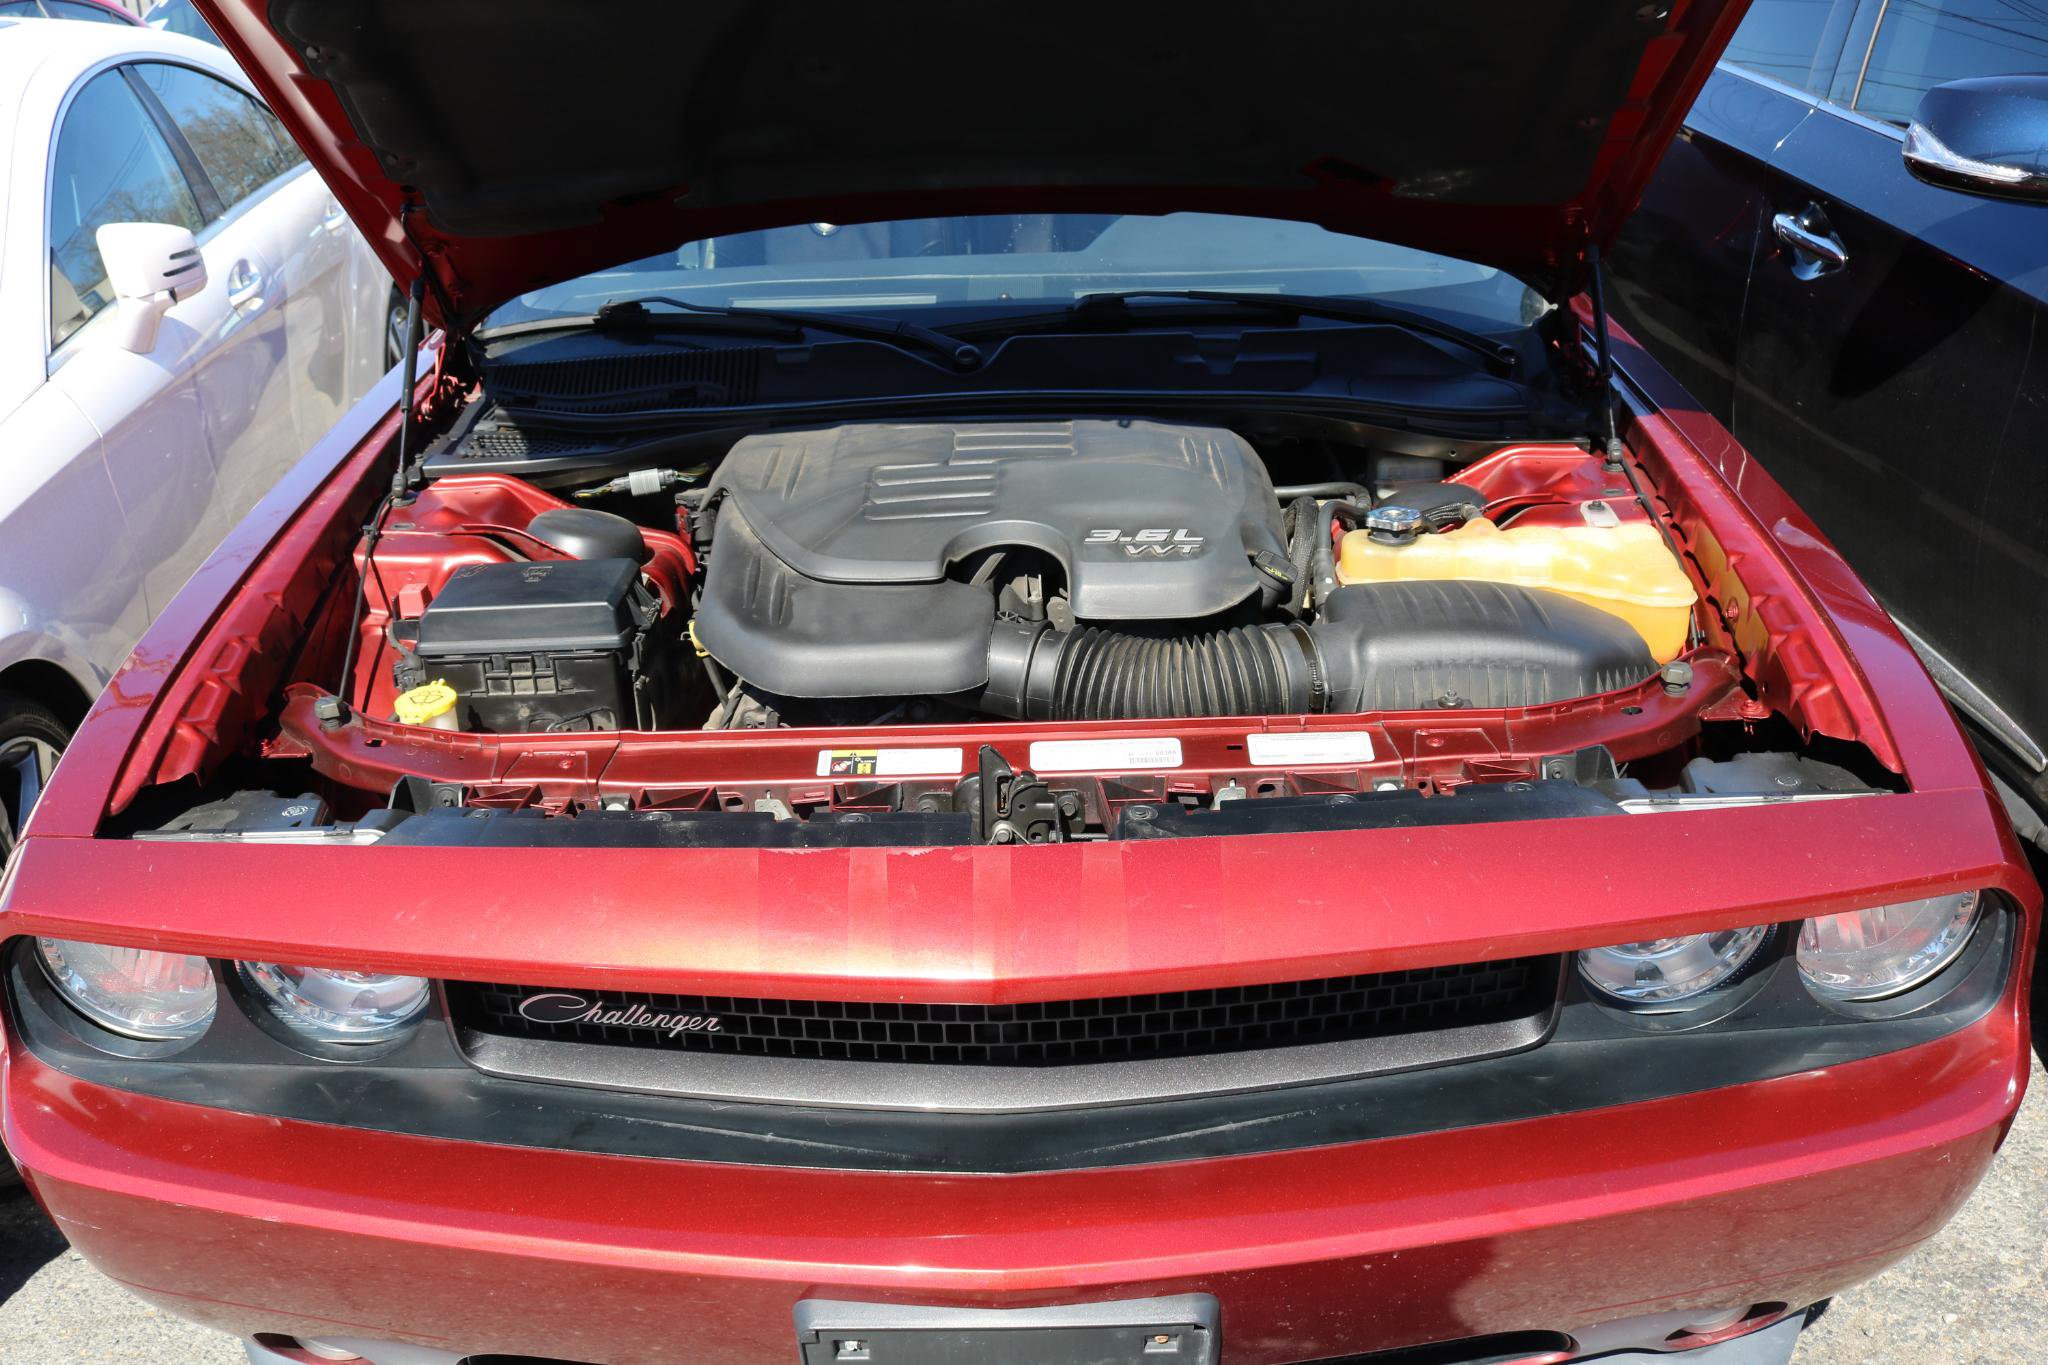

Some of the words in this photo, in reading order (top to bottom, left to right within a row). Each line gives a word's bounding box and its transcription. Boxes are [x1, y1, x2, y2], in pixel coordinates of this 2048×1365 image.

[1083, 528, 1206, 543] 3.6L
[1125, 544, 1202, 556] VVT
[518, 993, 722, 1038] Challenger
